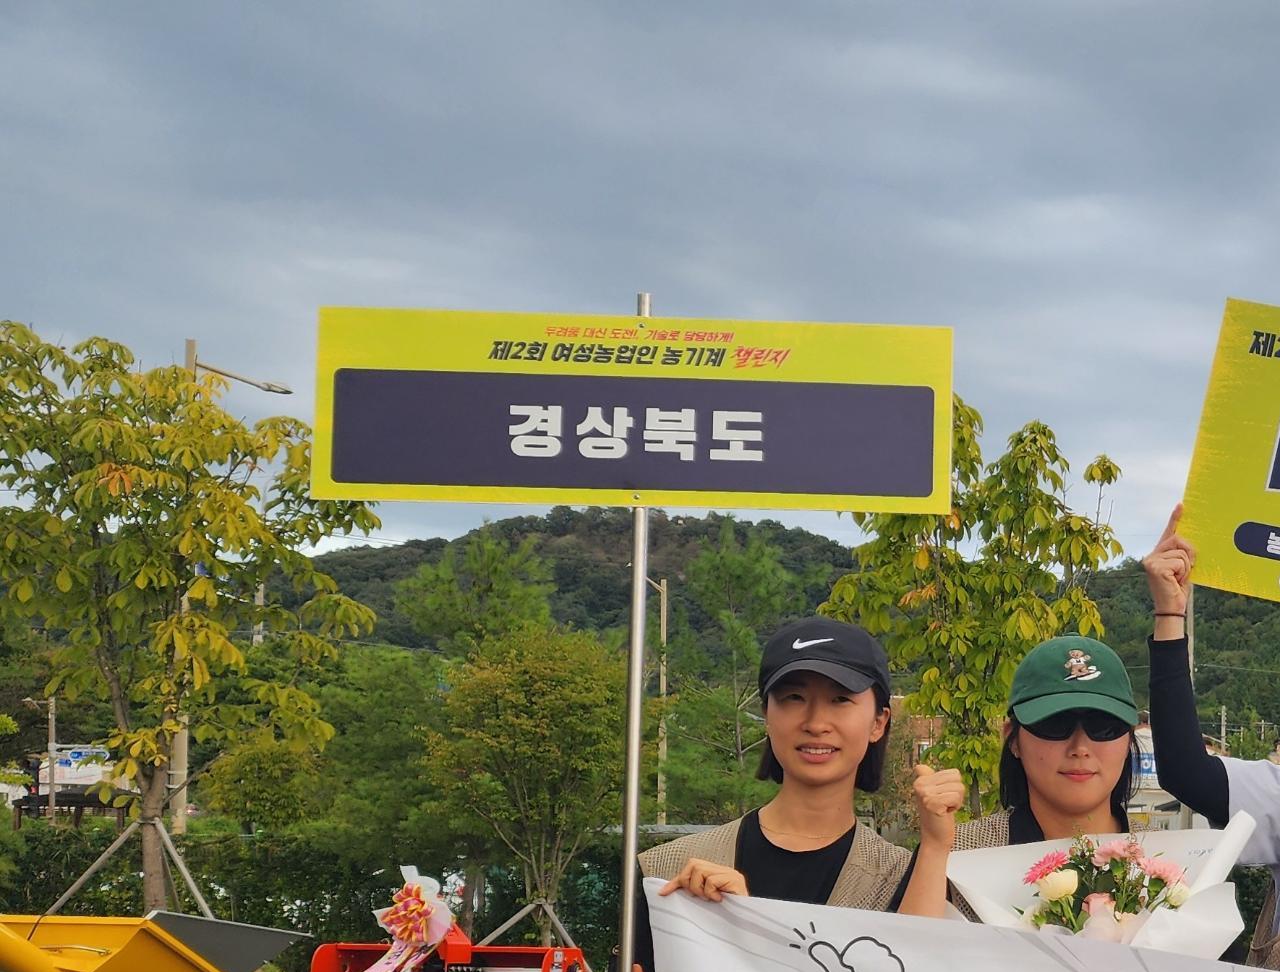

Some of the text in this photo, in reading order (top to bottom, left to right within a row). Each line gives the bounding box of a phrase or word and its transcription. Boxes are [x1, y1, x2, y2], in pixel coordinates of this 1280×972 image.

[582, 327, 608, 339] 대신
[644, 329, 681, 341] 기술로
[488, 340, 791, 369] 제2회 여성농업인 농기계 챌린지
[507, 404, 765, 462] 경상북도
